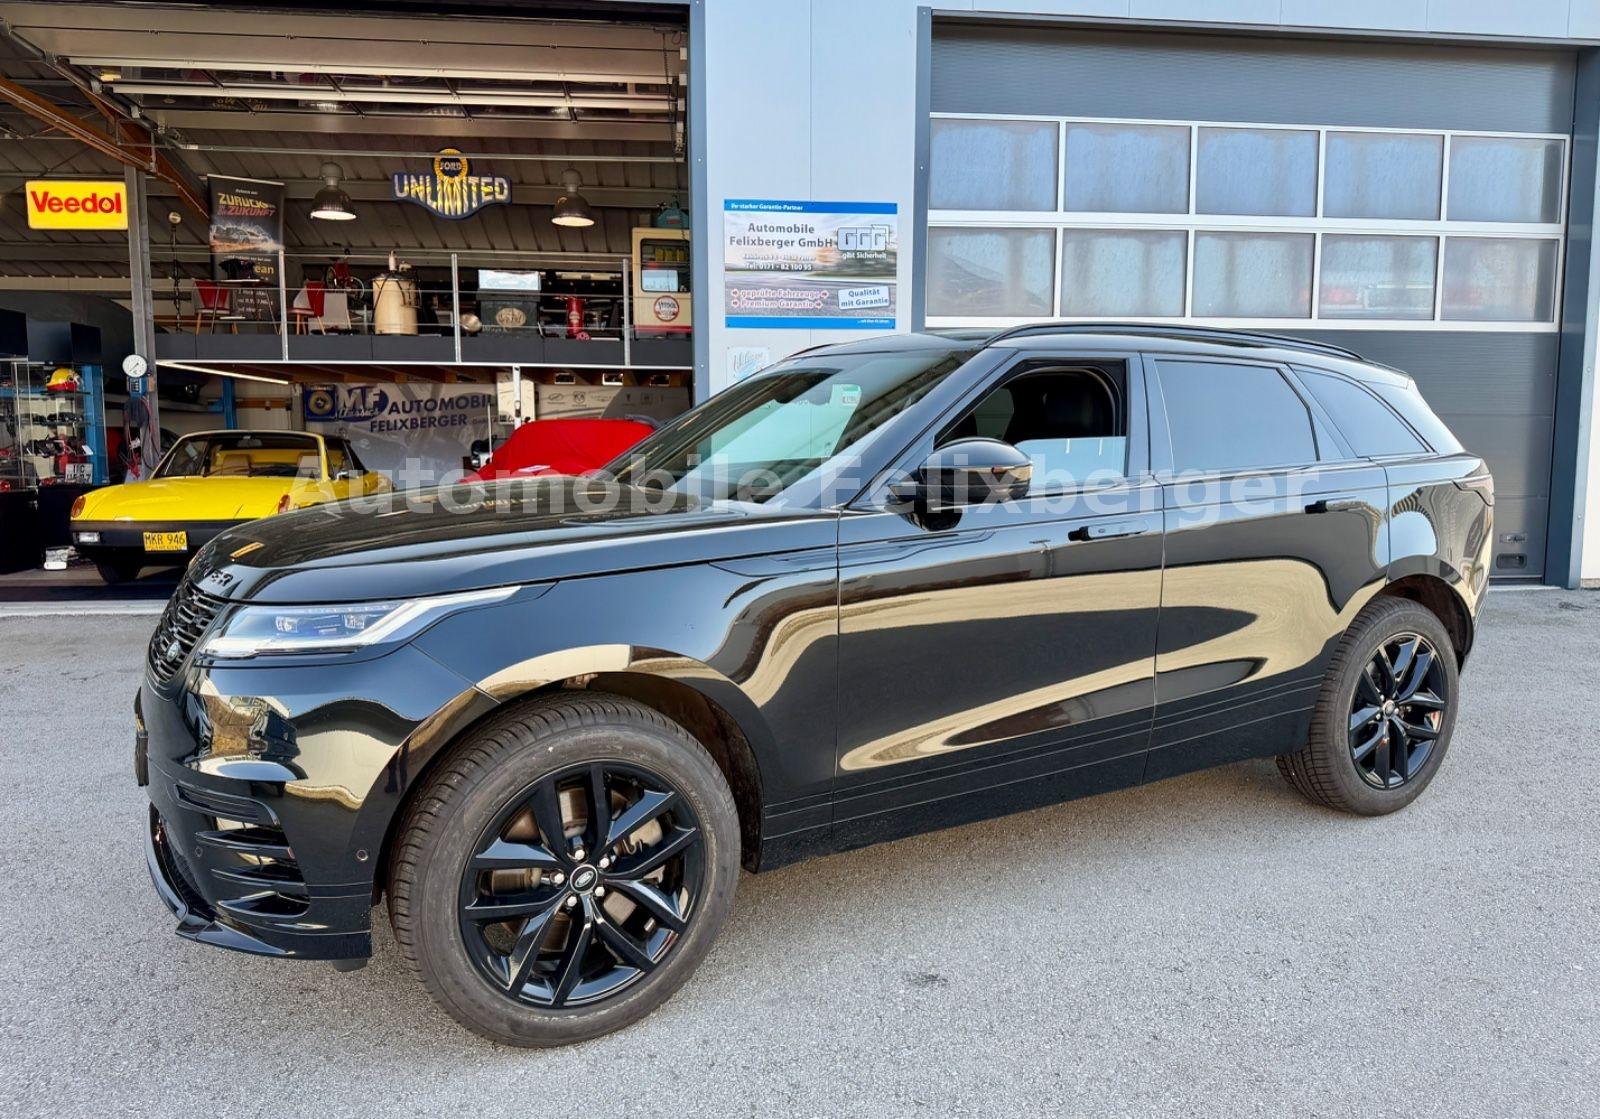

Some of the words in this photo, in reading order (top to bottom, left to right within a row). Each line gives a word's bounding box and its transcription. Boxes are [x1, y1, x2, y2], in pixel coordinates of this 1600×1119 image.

[440, 161, 462, 170] FORD
[394, 174, 509, 216] UNLIMITED
[31, 191, 122, 214] Veedol
[748, 223, 815, 234] Automobile
[729, 236, 795, 249] Felixberger
[798, 238, 833, 248] GmbH
[848, 289, 881, 298] Qualität
[779, 300, 814, 308] Garantie
[855, 297, 889, 306] Garantie
[370, 414, 468, 433] FELIXBERGER
[145, 533, 163, 545] MKR
[167, 533, 186, 545] 946
